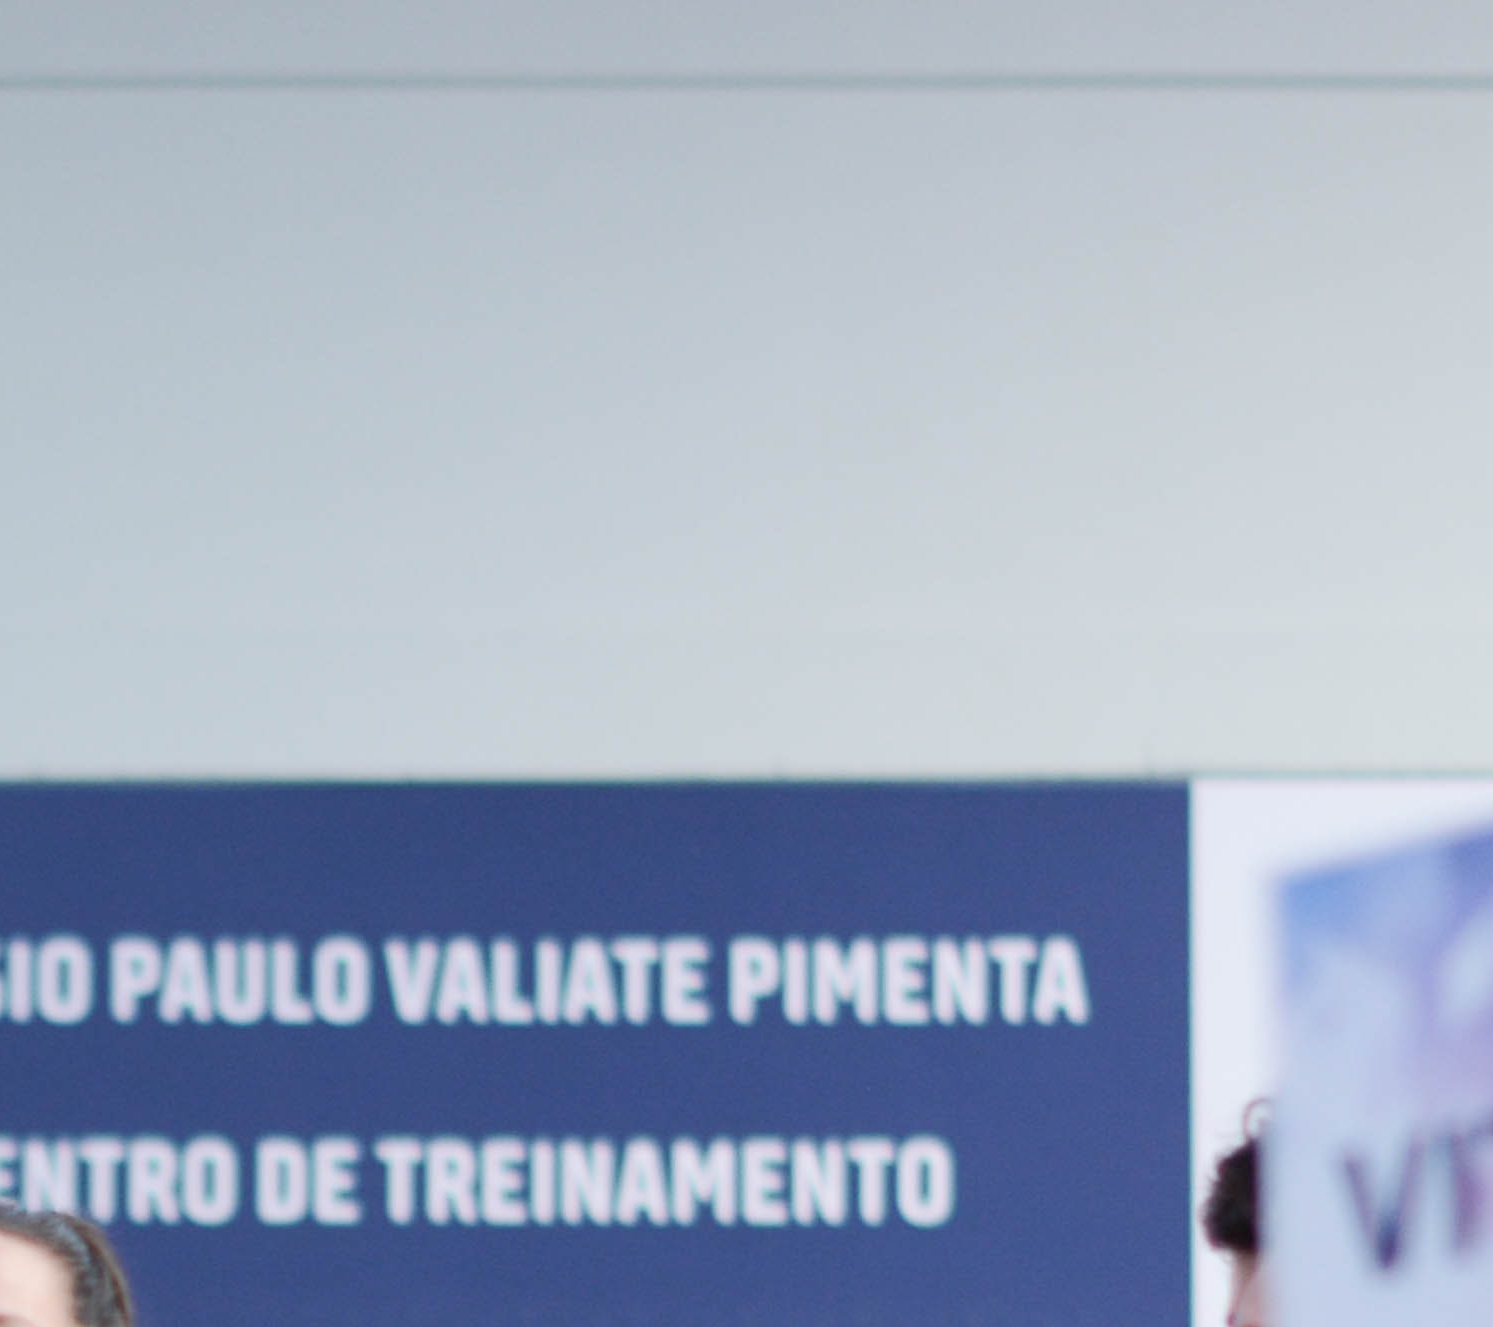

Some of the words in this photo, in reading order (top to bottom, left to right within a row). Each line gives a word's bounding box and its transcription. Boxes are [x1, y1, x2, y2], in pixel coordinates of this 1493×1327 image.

[110, 935, 371, 1026] PAULO
[383, 935, 712, 1026] VALIATE
[727, 935, 1091, 1026] PIMENTA
[254, 1135, 362, 1226] DE
[374, 1135, 957, 1227] TREINAMENTO
